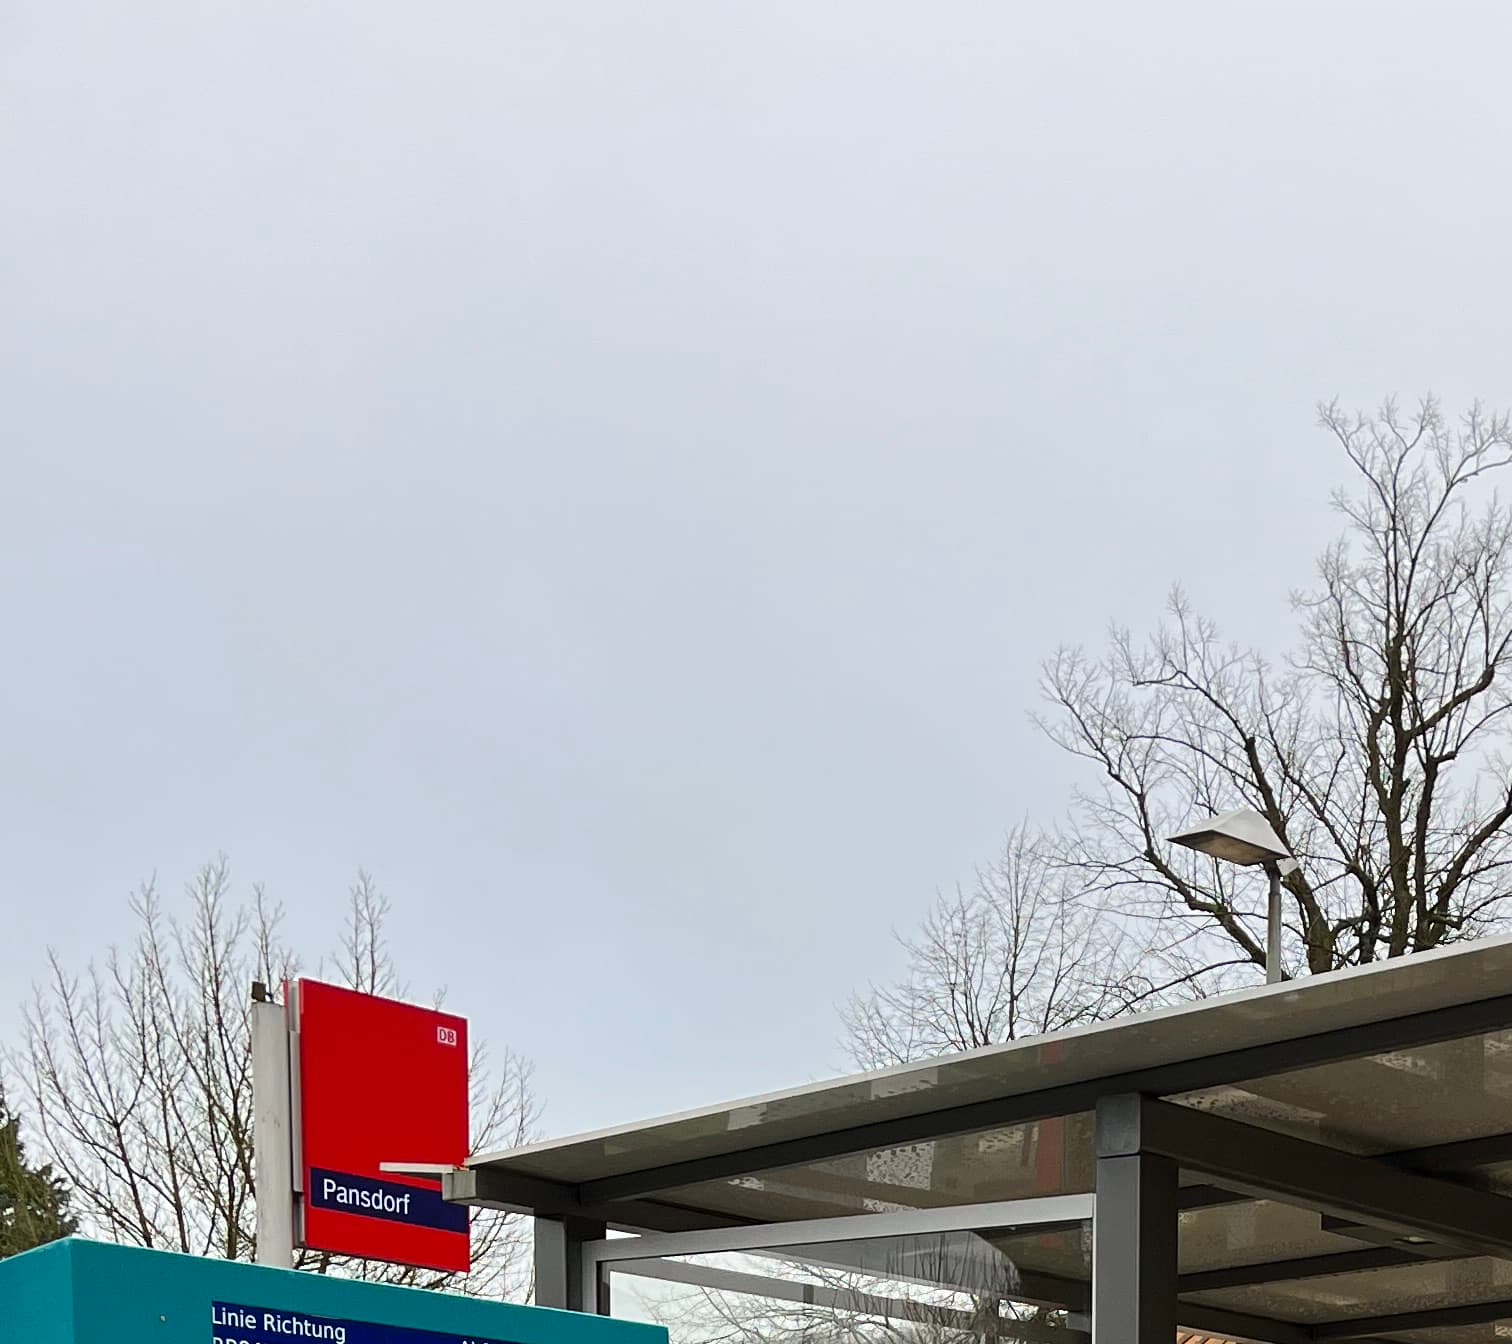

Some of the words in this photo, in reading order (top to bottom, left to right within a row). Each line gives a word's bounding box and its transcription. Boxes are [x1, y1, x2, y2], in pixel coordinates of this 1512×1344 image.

[438, 1028, 456, 1045] DB
[323, 1178, 411, 1215] Pansdorf
[211, 1306, 256, 1329] Linie
[263, 1313, 346, 1344] Richtung
